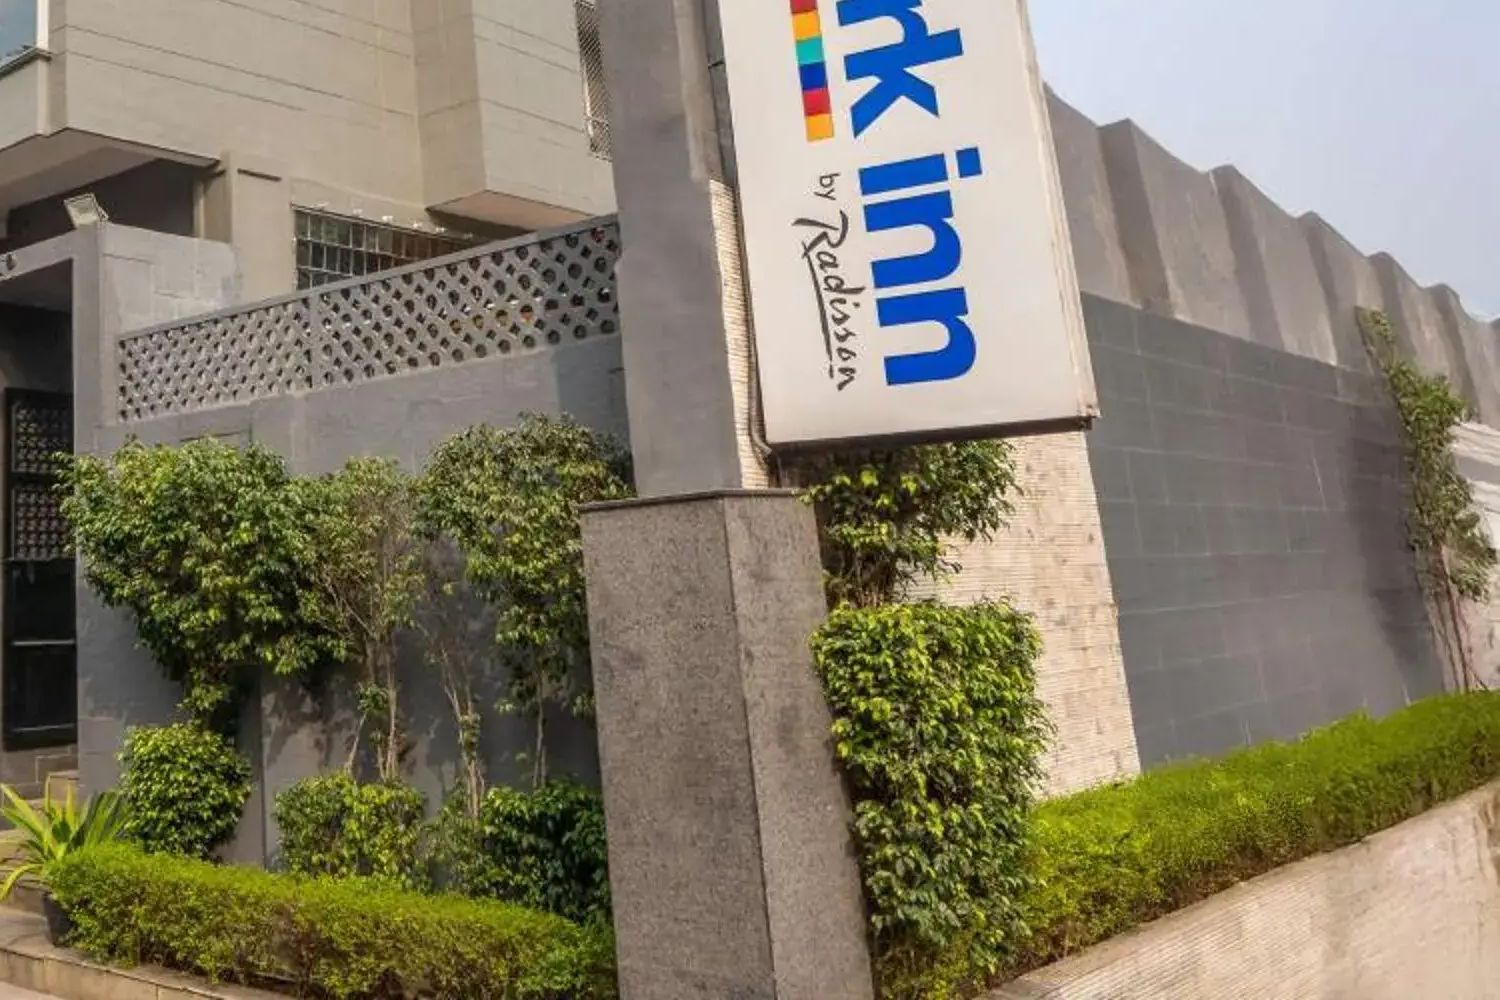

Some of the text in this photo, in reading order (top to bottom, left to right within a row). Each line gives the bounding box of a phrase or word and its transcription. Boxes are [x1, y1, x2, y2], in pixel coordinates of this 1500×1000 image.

[791, 173, 866, 391] by Radisson
[858, 147, 982, 386] inn
